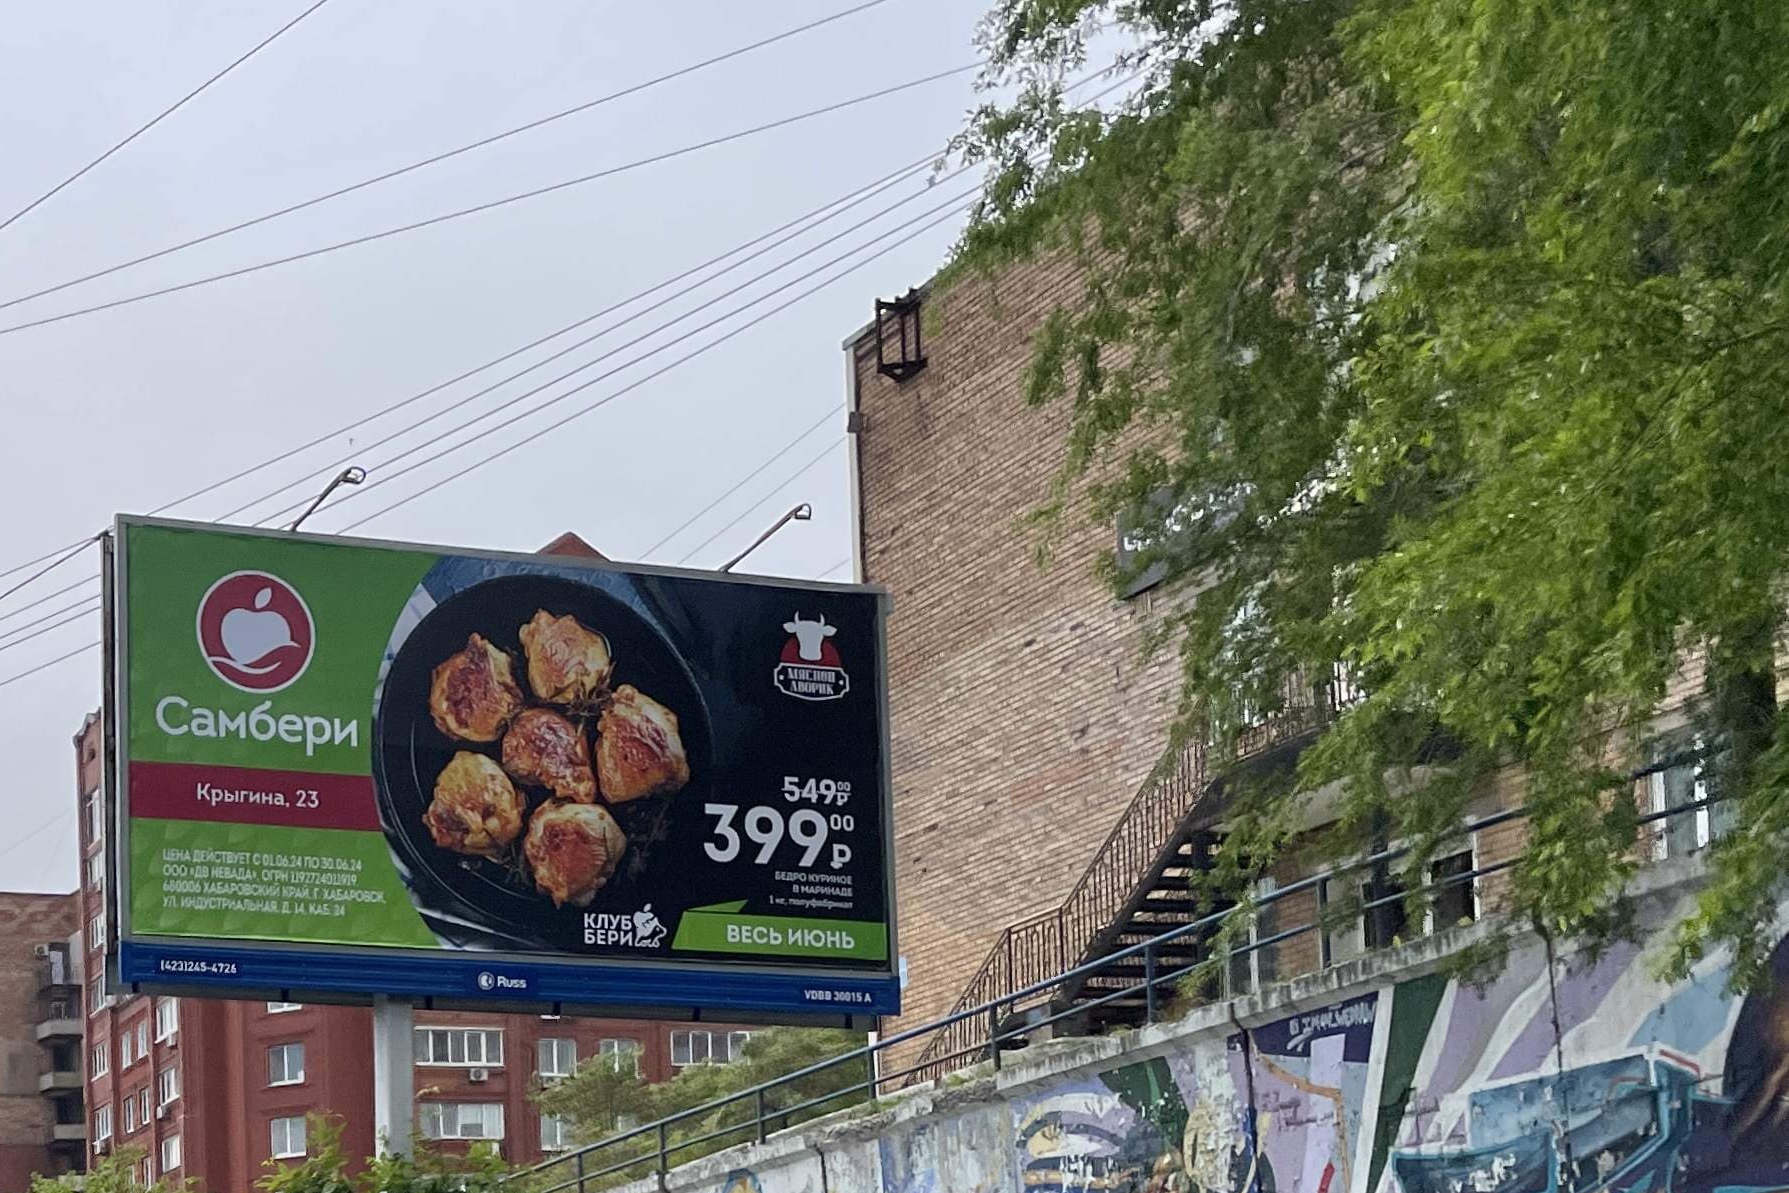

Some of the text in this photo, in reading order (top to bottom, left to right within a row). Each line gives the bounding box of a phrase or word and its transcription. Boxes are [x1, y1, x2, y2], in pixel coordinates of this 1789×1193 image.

[155, 695, 358, 756] Самбери
[196, 782, 319, 808] Крыгина, 23
[783, 776, 836, 804] 549
[704, 803, 828, 867] 399
[163, 848, 191, 861] ЦЕНА
[193, 848, 250, 864] ДЕЙСТВУЕТ
[262, 854, 302, 867] 01.06.24
[304, 856, 319, 869] ПО
[163, 864, 188, 876] ООО
[261, 869, 288, 881] ОГРН
[775, 871, 853, 885] БЕДРО КУРИНОЕ
[203, 881, 279, 897] ХАБАРОВСКИЙ
[792, 884, 853, 897] В МАРИНАДЕ
[583, 912, 632, 930] КЛУБ
[584, 929, 633, 946] БЕРИ
[727, 924, 855, 949] ВЕСЬ ИЮНЬ
[497, 975, 527, 988] Russ
